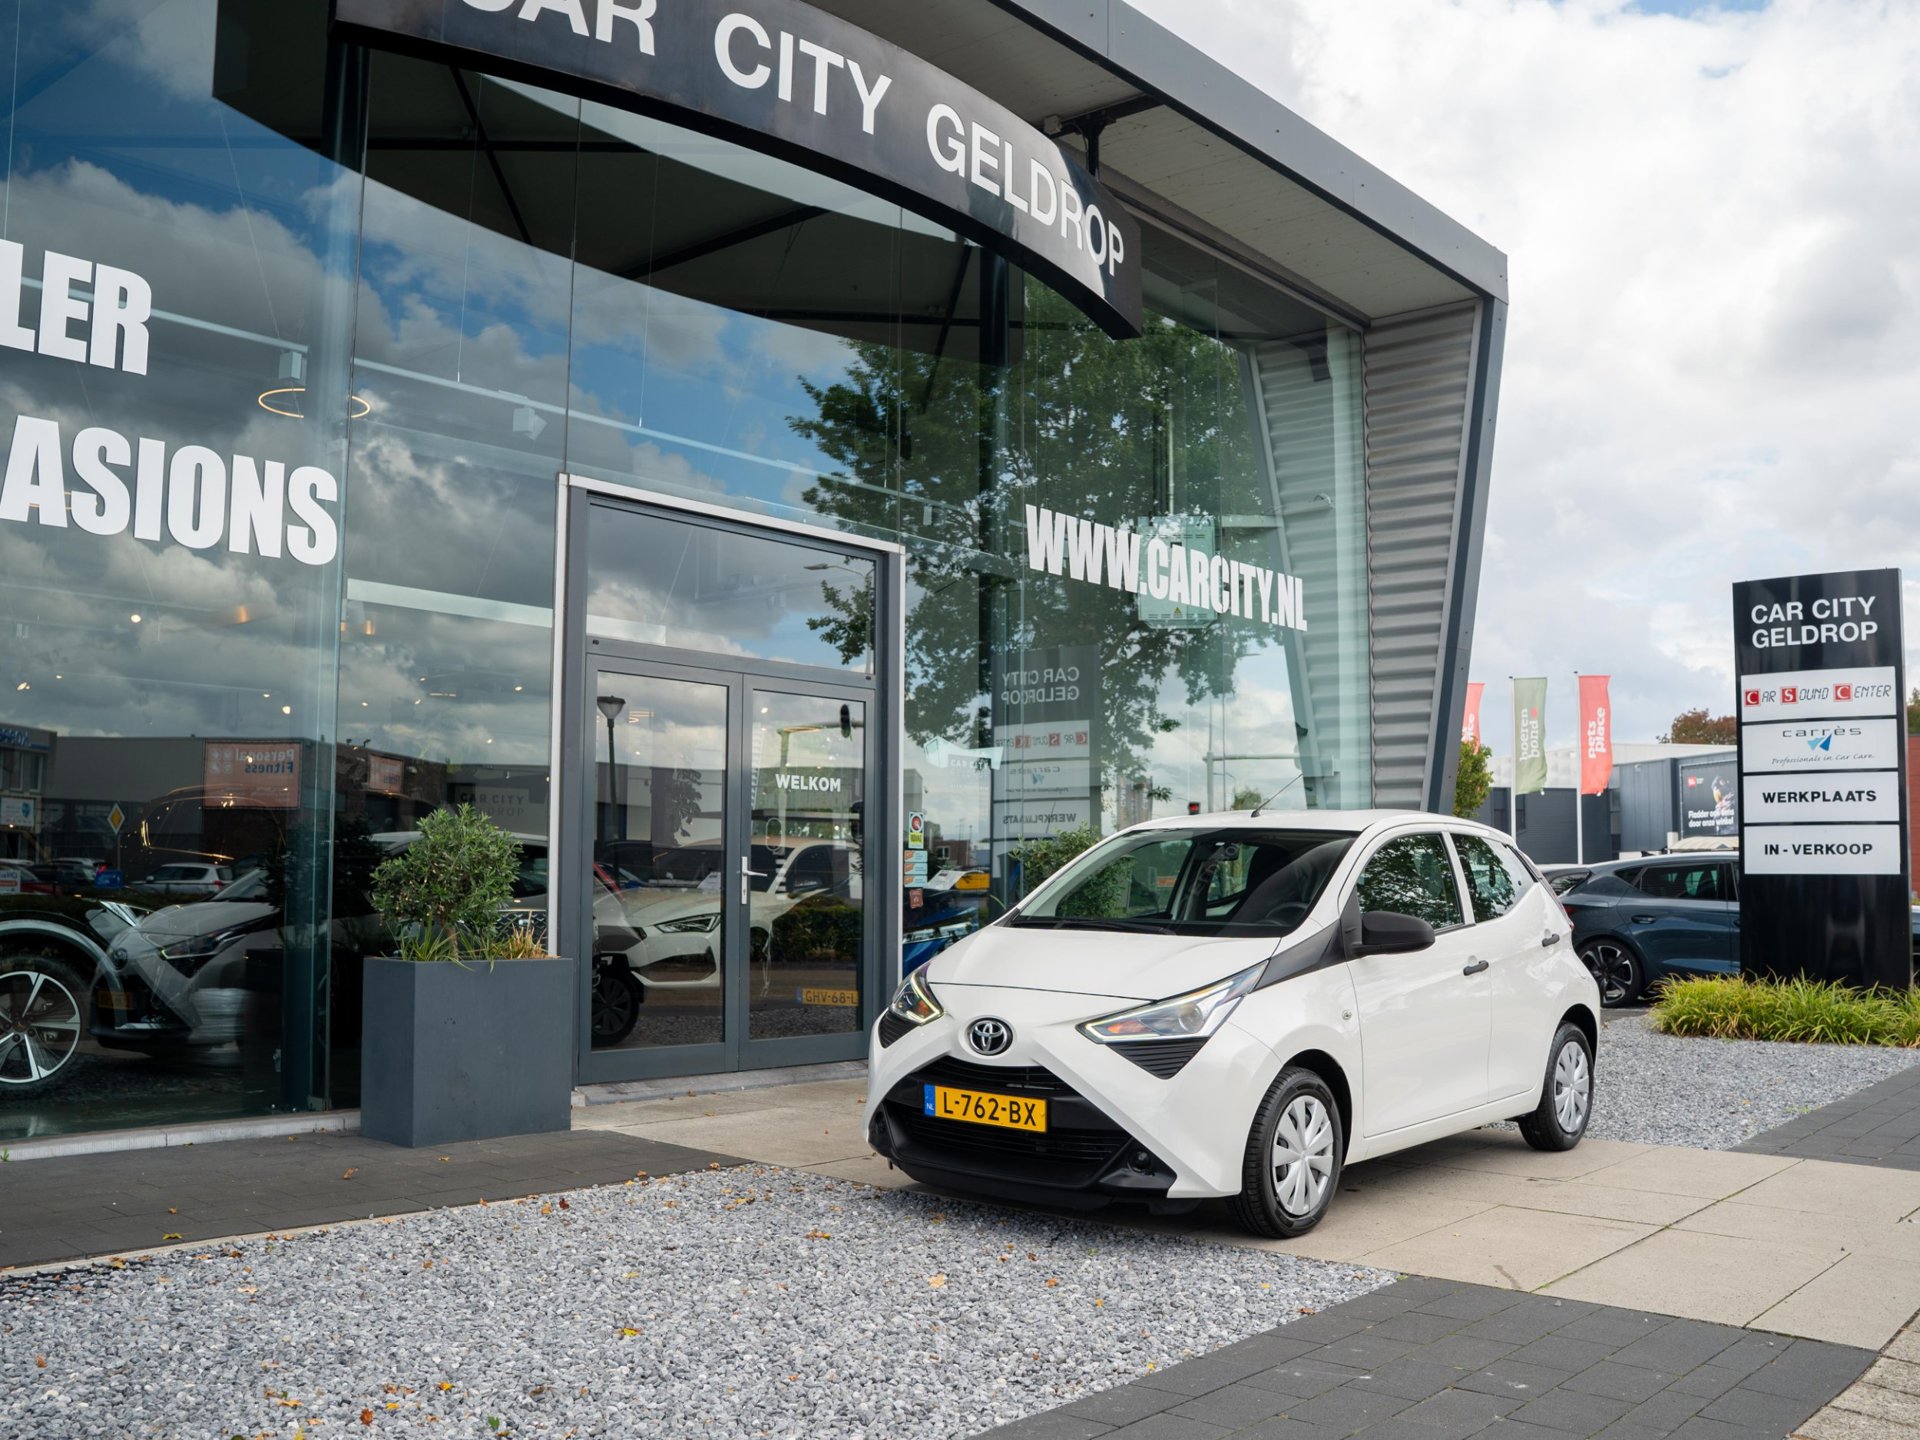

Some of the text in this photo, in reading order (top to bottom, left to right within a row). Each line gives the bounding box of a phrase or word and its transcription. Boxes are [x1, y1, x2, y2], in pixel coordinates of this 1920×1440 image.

[714, 13, 1124, 277] CITY GELDROP
[0, 238, 151, 376] LER
[0, 414, 338, 565] ASIONS
[1025, 503, 1308, 632] WWW.CARCITY.NL
[1751, 596, 1876, 624] CAR CITY
[1751, 621, 1878, 649] GELDROP
[1745, 684, 1891, 705] CAR SOUND CENTER
[1519, 708, 1529, 761] boeren
[1528, 720, 1540, 758] bond
[1587, 720, 1597, 759] pets
[1595, 707, 1606, 753] place
[1782, 725, 1861, 738] carrès
[1835, 753, 1850, 761] Car
[775, 773, 841, 793] WELKOM
[1762, 790, 1877, 803] WERKPLAATS
[1792, 843, 1873, 855] VERKOOP
[943, 1091, 1037, 1126] L-762-BX
